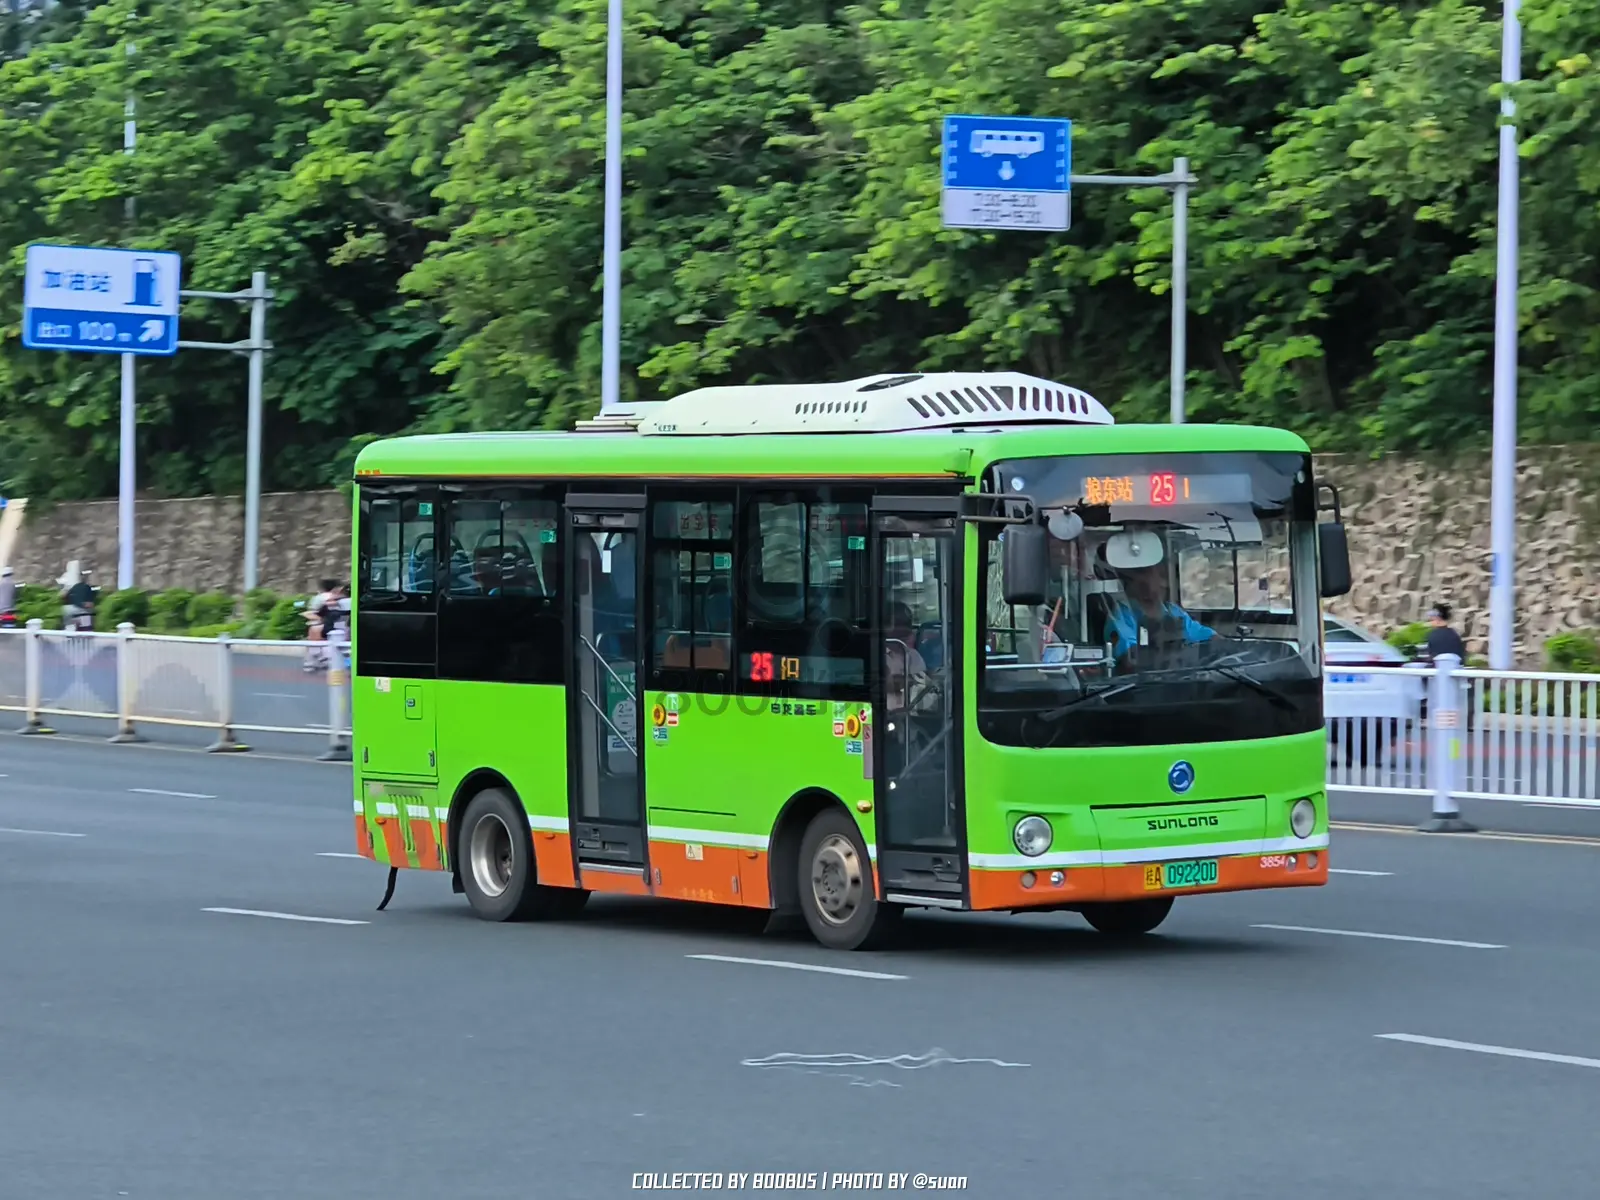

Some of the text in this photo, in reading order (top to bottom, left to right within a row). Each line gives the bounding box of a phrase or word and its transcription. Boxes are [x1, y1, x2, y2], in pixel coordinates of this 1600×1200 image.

[1150, 474, 1175, 503] 25
[750, 652, 774, 682] 25
[1147, 815, 1219, 831] SUNLONG
